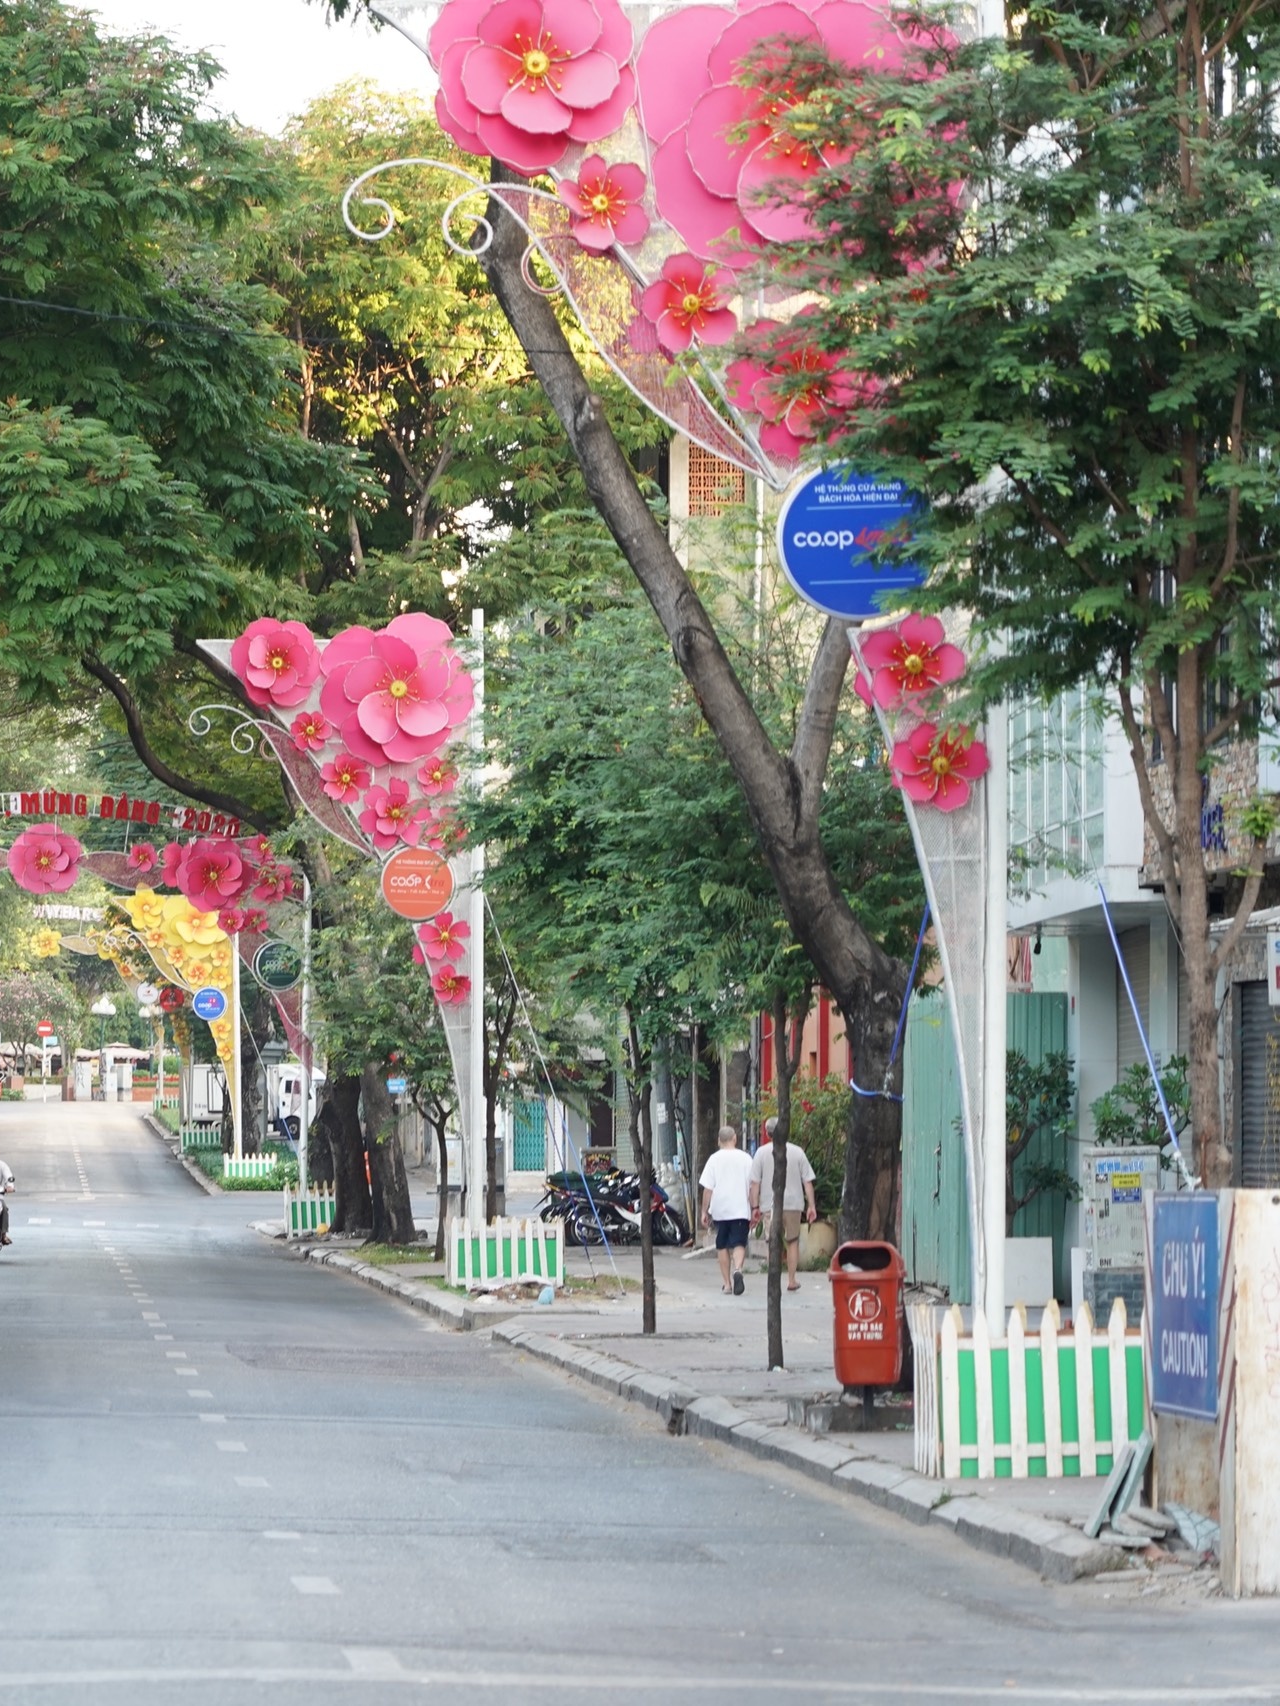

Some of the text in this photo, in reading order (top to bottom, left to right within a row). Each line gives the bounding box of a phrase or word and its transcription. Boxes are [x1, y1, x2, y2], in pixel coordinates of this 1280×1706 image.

[814, 485, 826, 495] HỆ
[819, 492, 842, 503] BÁCH
[863, 492, 883, 503] HIỆN
[883, 491, 898, 502] ĐẠI
[793, 530, 854, 550] co.op
[20, 787, 87, 816] MỪNG
[99, 792, 161, 825] ĐẢNG
[1161, 1329, 1208, 1379] CAUTION!
